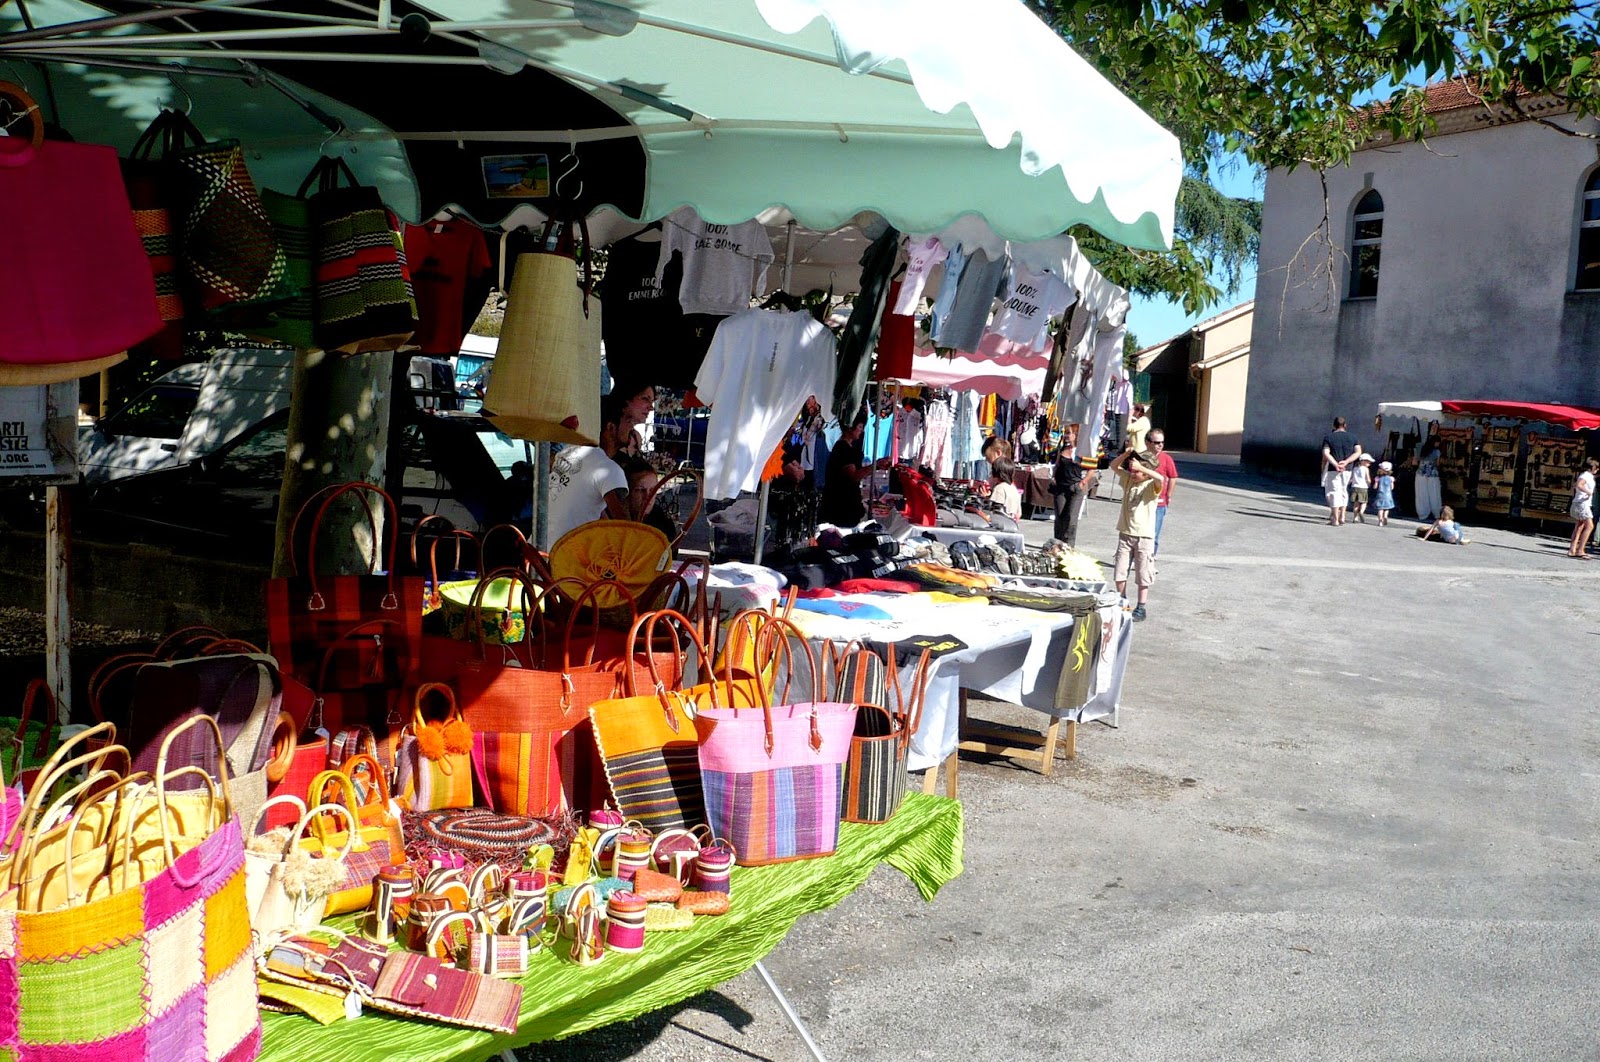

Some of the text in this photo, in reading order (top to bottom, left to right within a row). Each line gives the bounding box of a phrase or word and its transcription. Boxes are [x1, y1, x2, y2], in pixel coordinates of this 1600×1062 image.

[1015, 283, 1038, 299] 100%
[0, 421, 25, 436] RTI
[0, 437, 28, 450] STE
